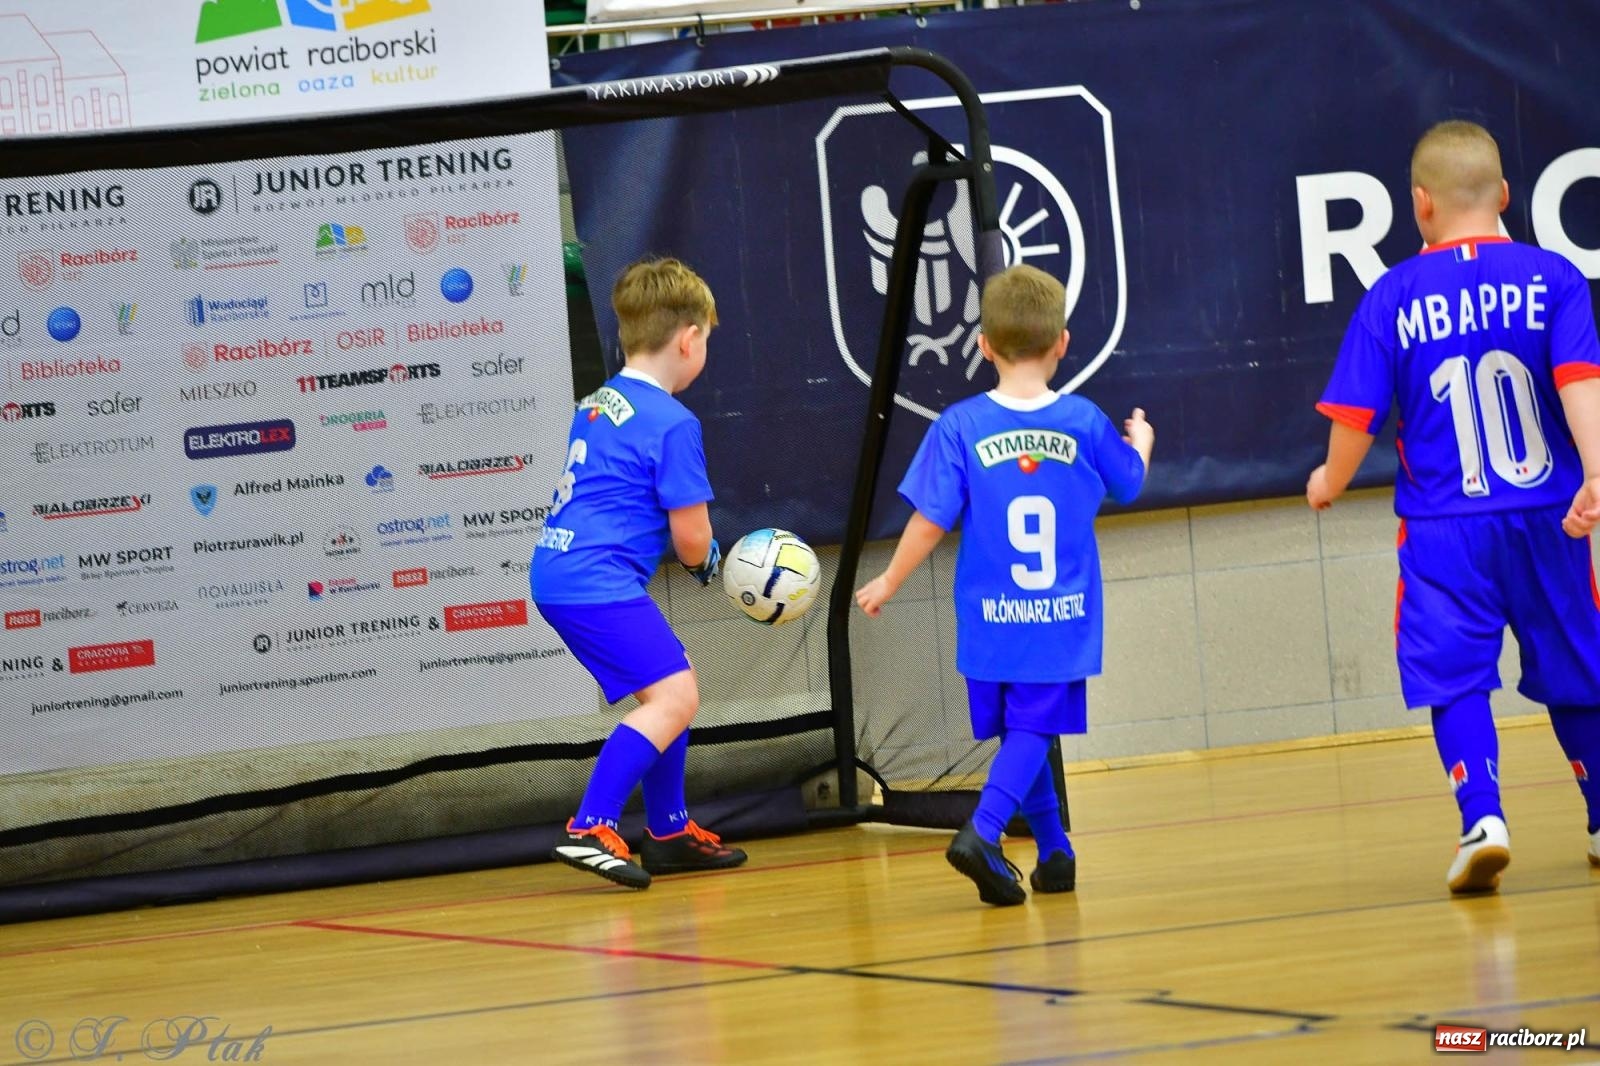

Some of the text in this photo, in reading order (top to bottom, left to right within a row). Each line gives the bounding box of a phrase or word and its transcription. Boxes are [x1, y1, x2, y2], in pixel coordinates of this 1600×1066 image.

[196, 28, 437, 83] powiat raciborski
[199, 64, 438, 102] zielona oaza kultur
[589, 70, 736, 100] YAKIMASPORT
[253, 162, 367, 196] JUNIOR
[377, 148, 512, 182] TRENING
[445, 210, 520, 231] Racibórz
[60, 247, 138, 267] Racibórz
[1397, 275, 1548, 350] MBAPPÉ
[213, 317, 504, 363] Racibórz OSiR Biblioteka
[21, 356, 122, 381] Biblioteka
[472, 352, 525, 378] safer
[180, 380, 257, 402] MIESZKO
[87, 392, 142, 417] safer
[1429, 350, 1552, 497] 10
[188, 426, 291, 451] ELEKTROLEX
[981, 434, 1074, 460] TYMBARK
[234, 472, 345, 496] Alfred Mainka
[463, 512, 495, 527] MW
[1007, 495, 1057, 590] 9
[78, 545, 174, 569] MW SPORT
[982, 593, 1085, 623] WŁÓKNIARZ KIETRZ
[285, 623, 345, 643] JUNIOR
[352, 615, 421, 635] TRENING
[428, 616, 440, 631] &
[52, 657, 64, 672] &
